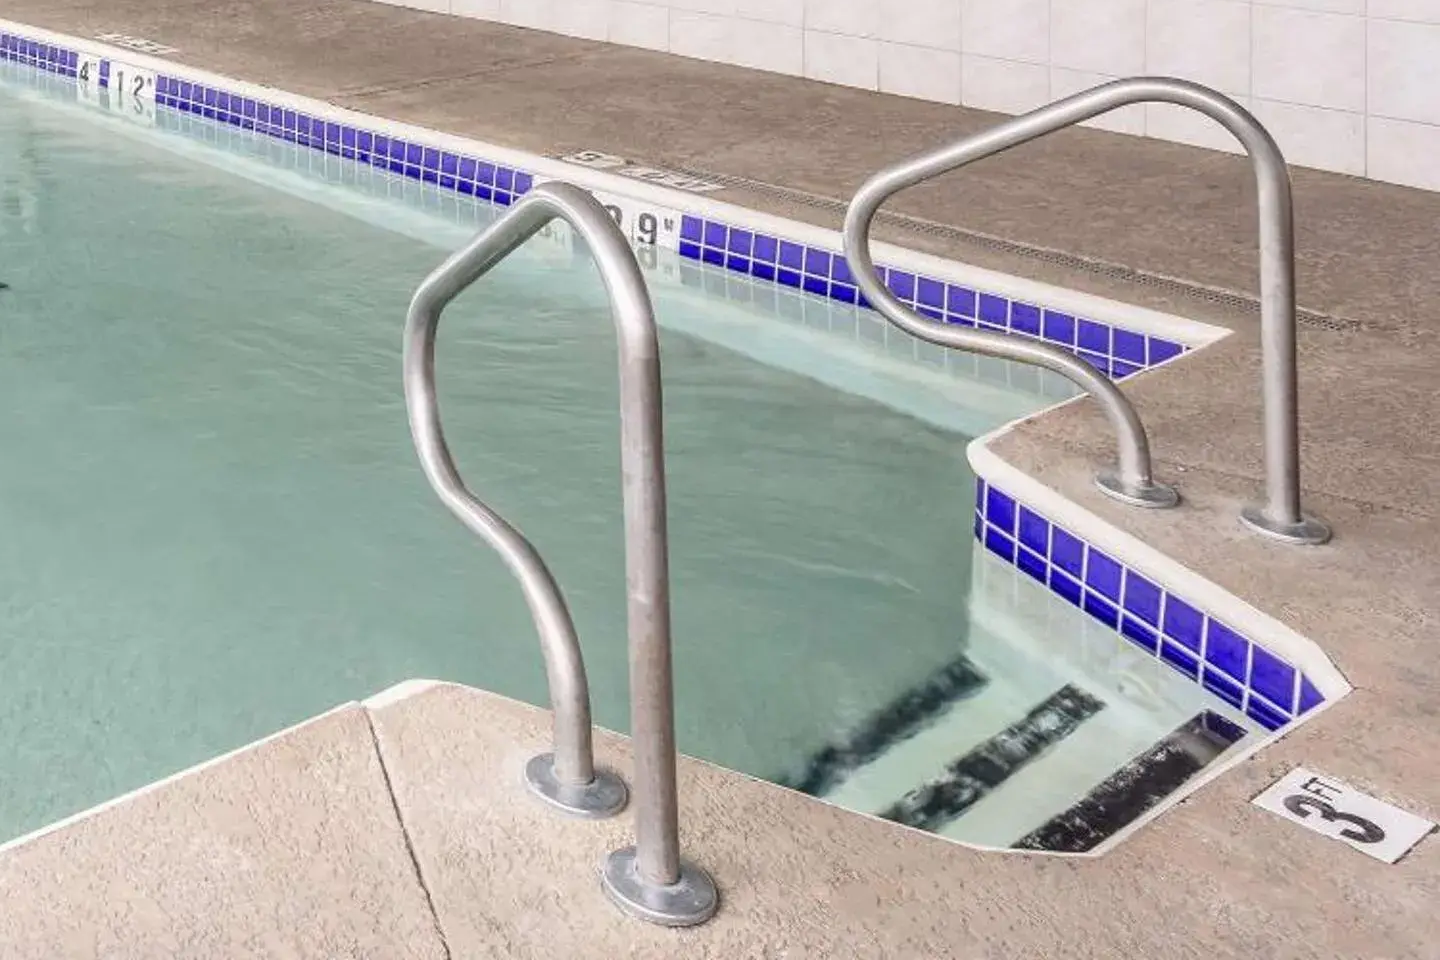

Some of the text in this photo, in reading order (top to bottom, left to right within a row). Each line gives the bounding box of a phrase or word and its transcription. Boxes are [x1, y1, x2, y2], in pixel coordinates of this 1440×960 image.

[80, 61, 89, 81] 4
[1283, 777, 1385, 843] 3 FT
